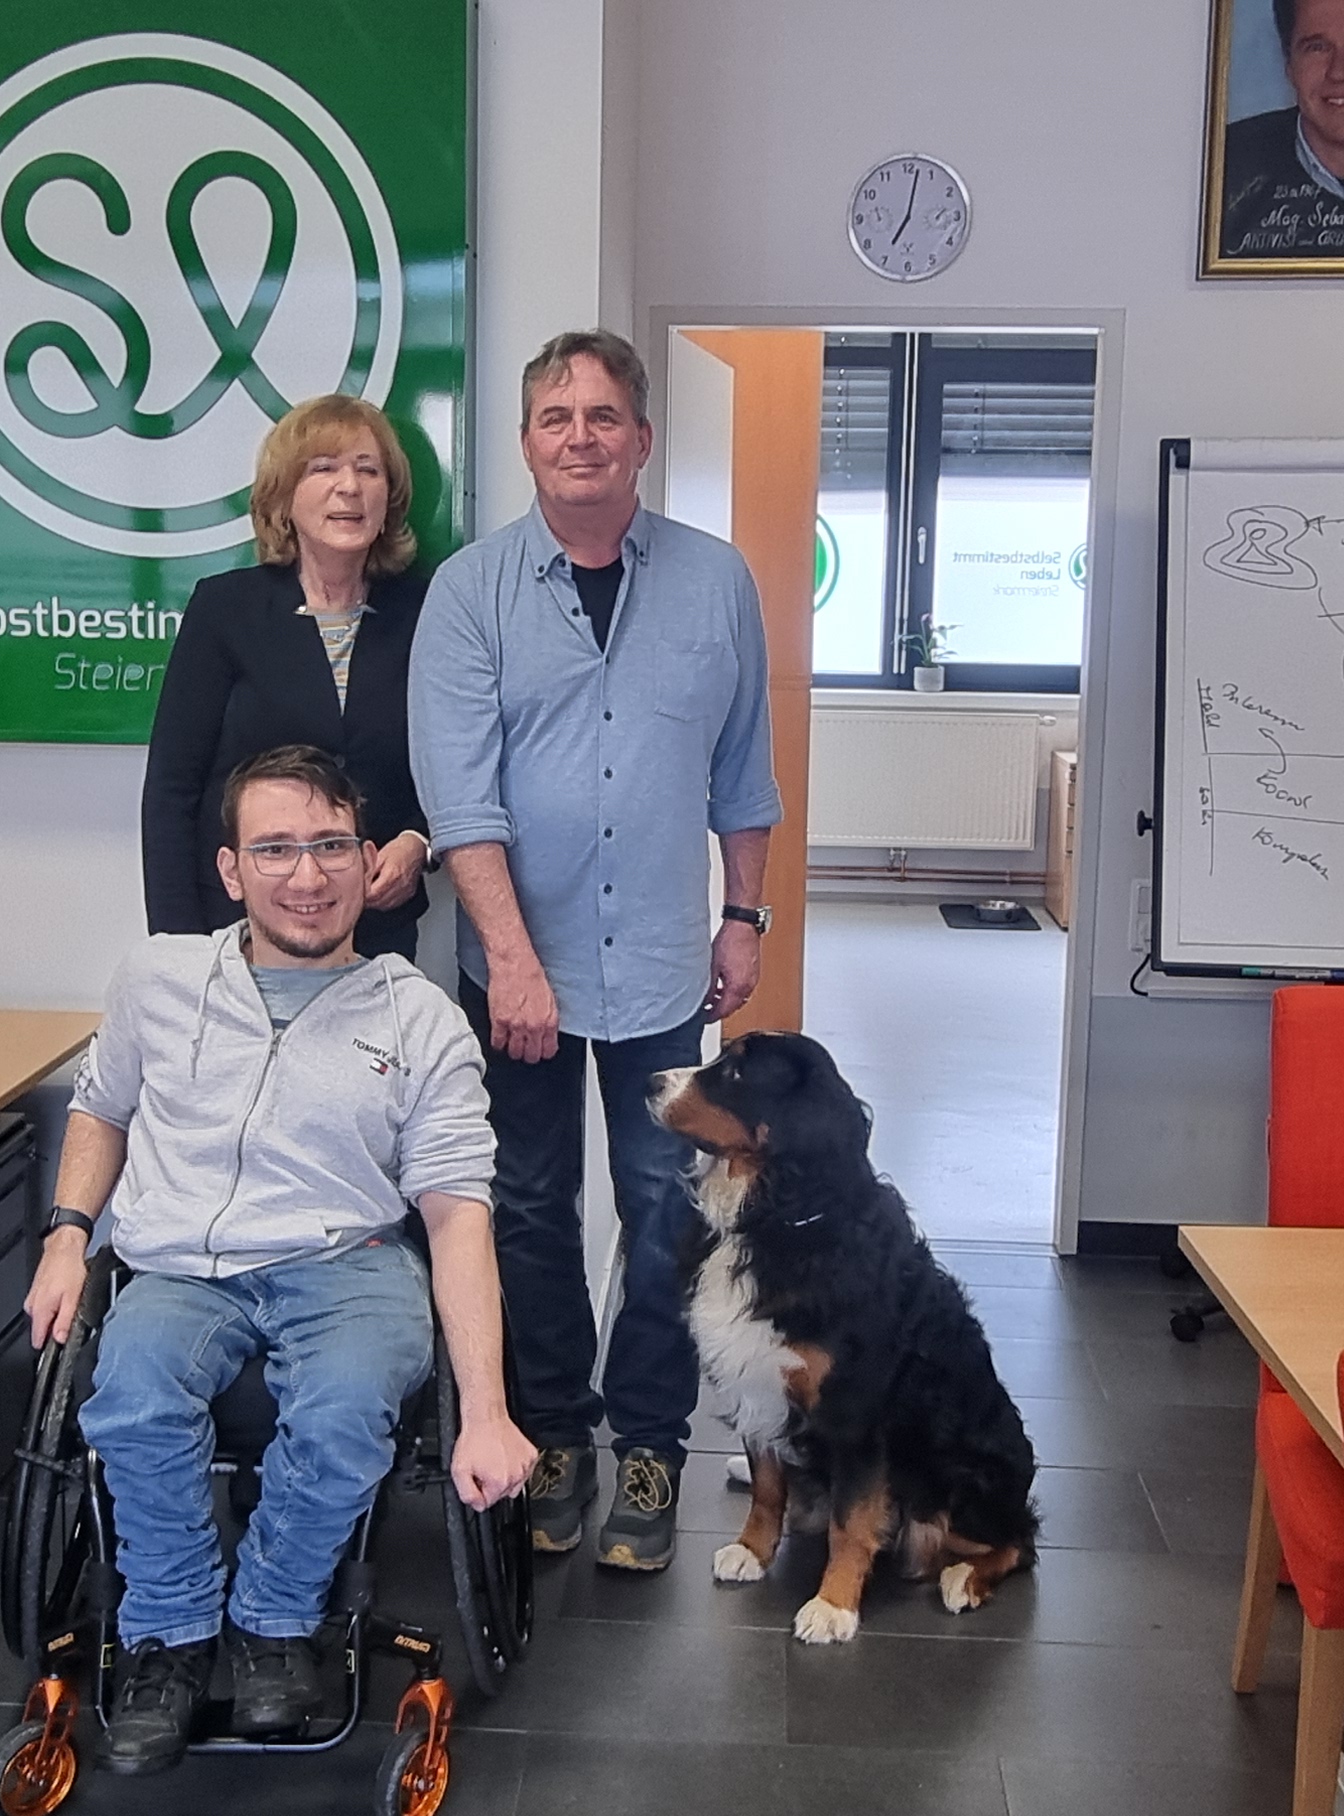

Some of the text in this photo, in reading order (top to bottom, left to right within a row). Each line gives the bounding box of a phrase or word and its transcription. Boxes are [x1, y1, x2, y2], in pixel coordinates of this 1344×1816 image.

[902, 163, 915, 174] 12
[879, 171, 891, 182] 11
[929, 170, 934, 180] 1
[863, 189, 876, 200] 10
[946, 186, 954, 198] 2
[855, 213, 864, 225] 9
[953, 210, 961, 221] 3
[863, 239, 872, 250] 8
[945, 236, 954, 246] 4
[881, 256, 889, 265] 7
[928, 254, 937, 266] 5
[904, 261, 912, 272] 6
[54, 652, 165, 692] Steier
[352, 1037, 390, 1059] TOMMY
